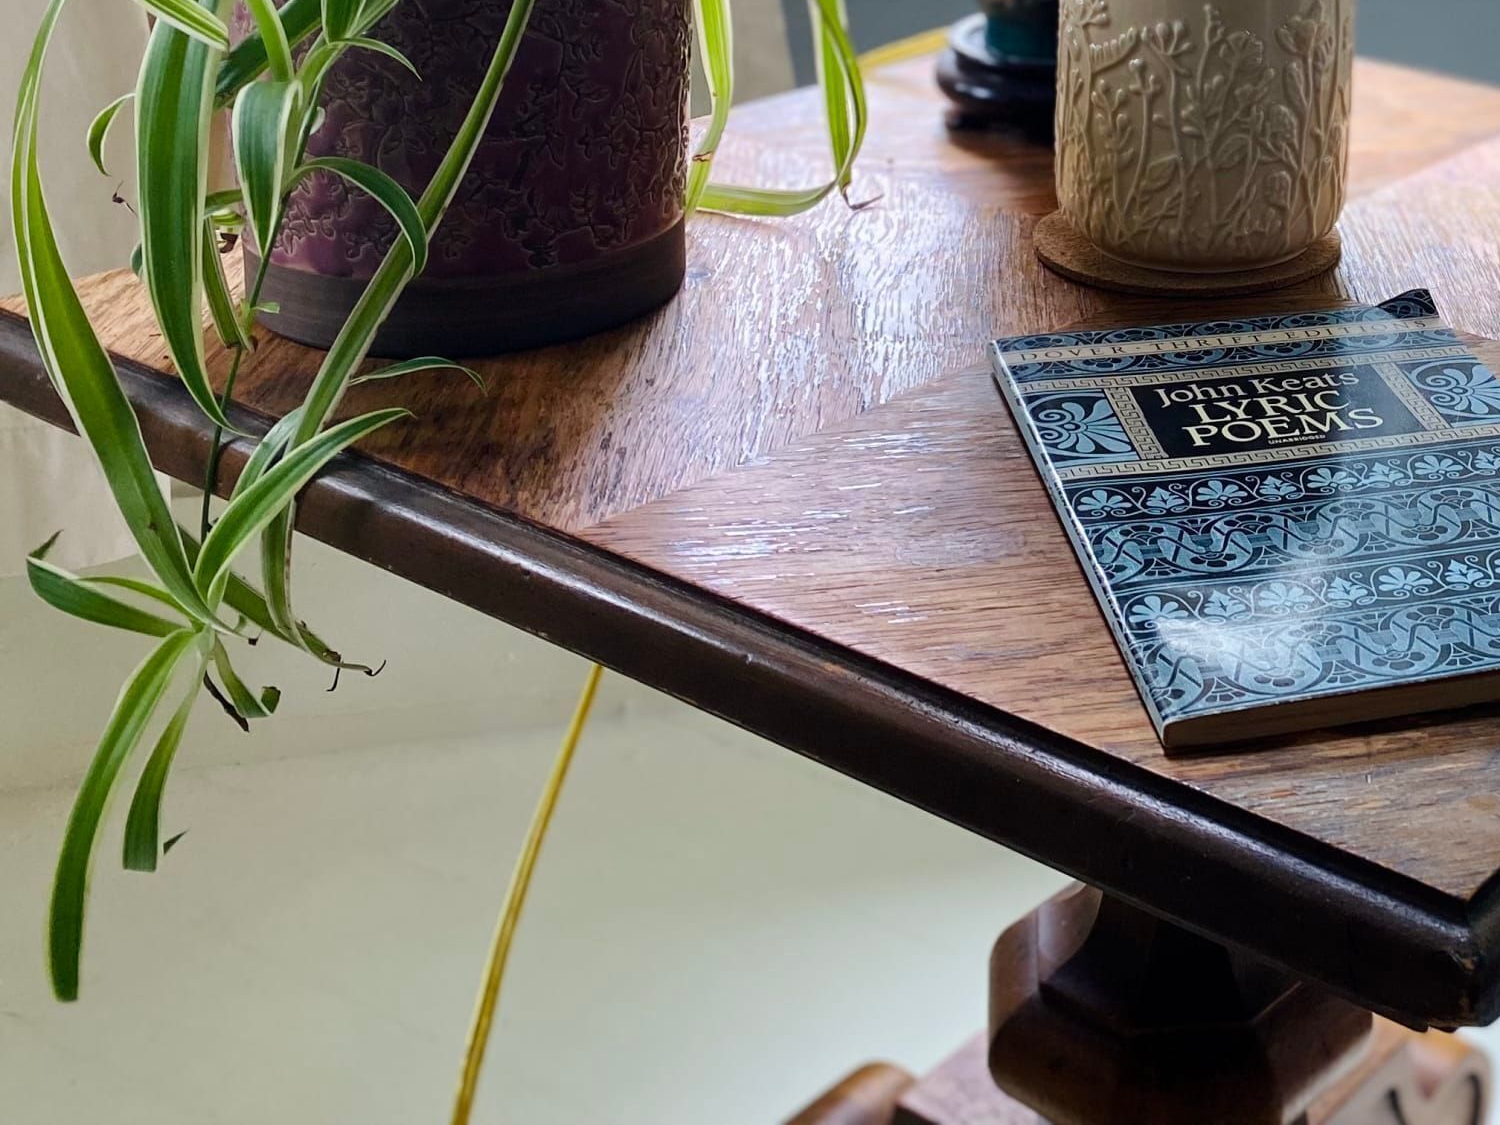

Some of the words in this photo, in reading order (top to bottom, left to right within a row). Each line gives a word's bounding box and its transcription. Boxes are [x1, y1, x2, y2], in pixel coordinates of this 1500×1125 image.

[1021, 346, 1124, 361] DOVER
[1151, 335, 1262, 351] THRIFT
[1285, 319, 1427, 339] EDITIONS
[1154, 382, 1247, 408] John
[1248, 372, 1360, 395] Keats
[1189, 390, 1350, 424] LYRIC
[1181, 407, 1384, 447] POEMS
